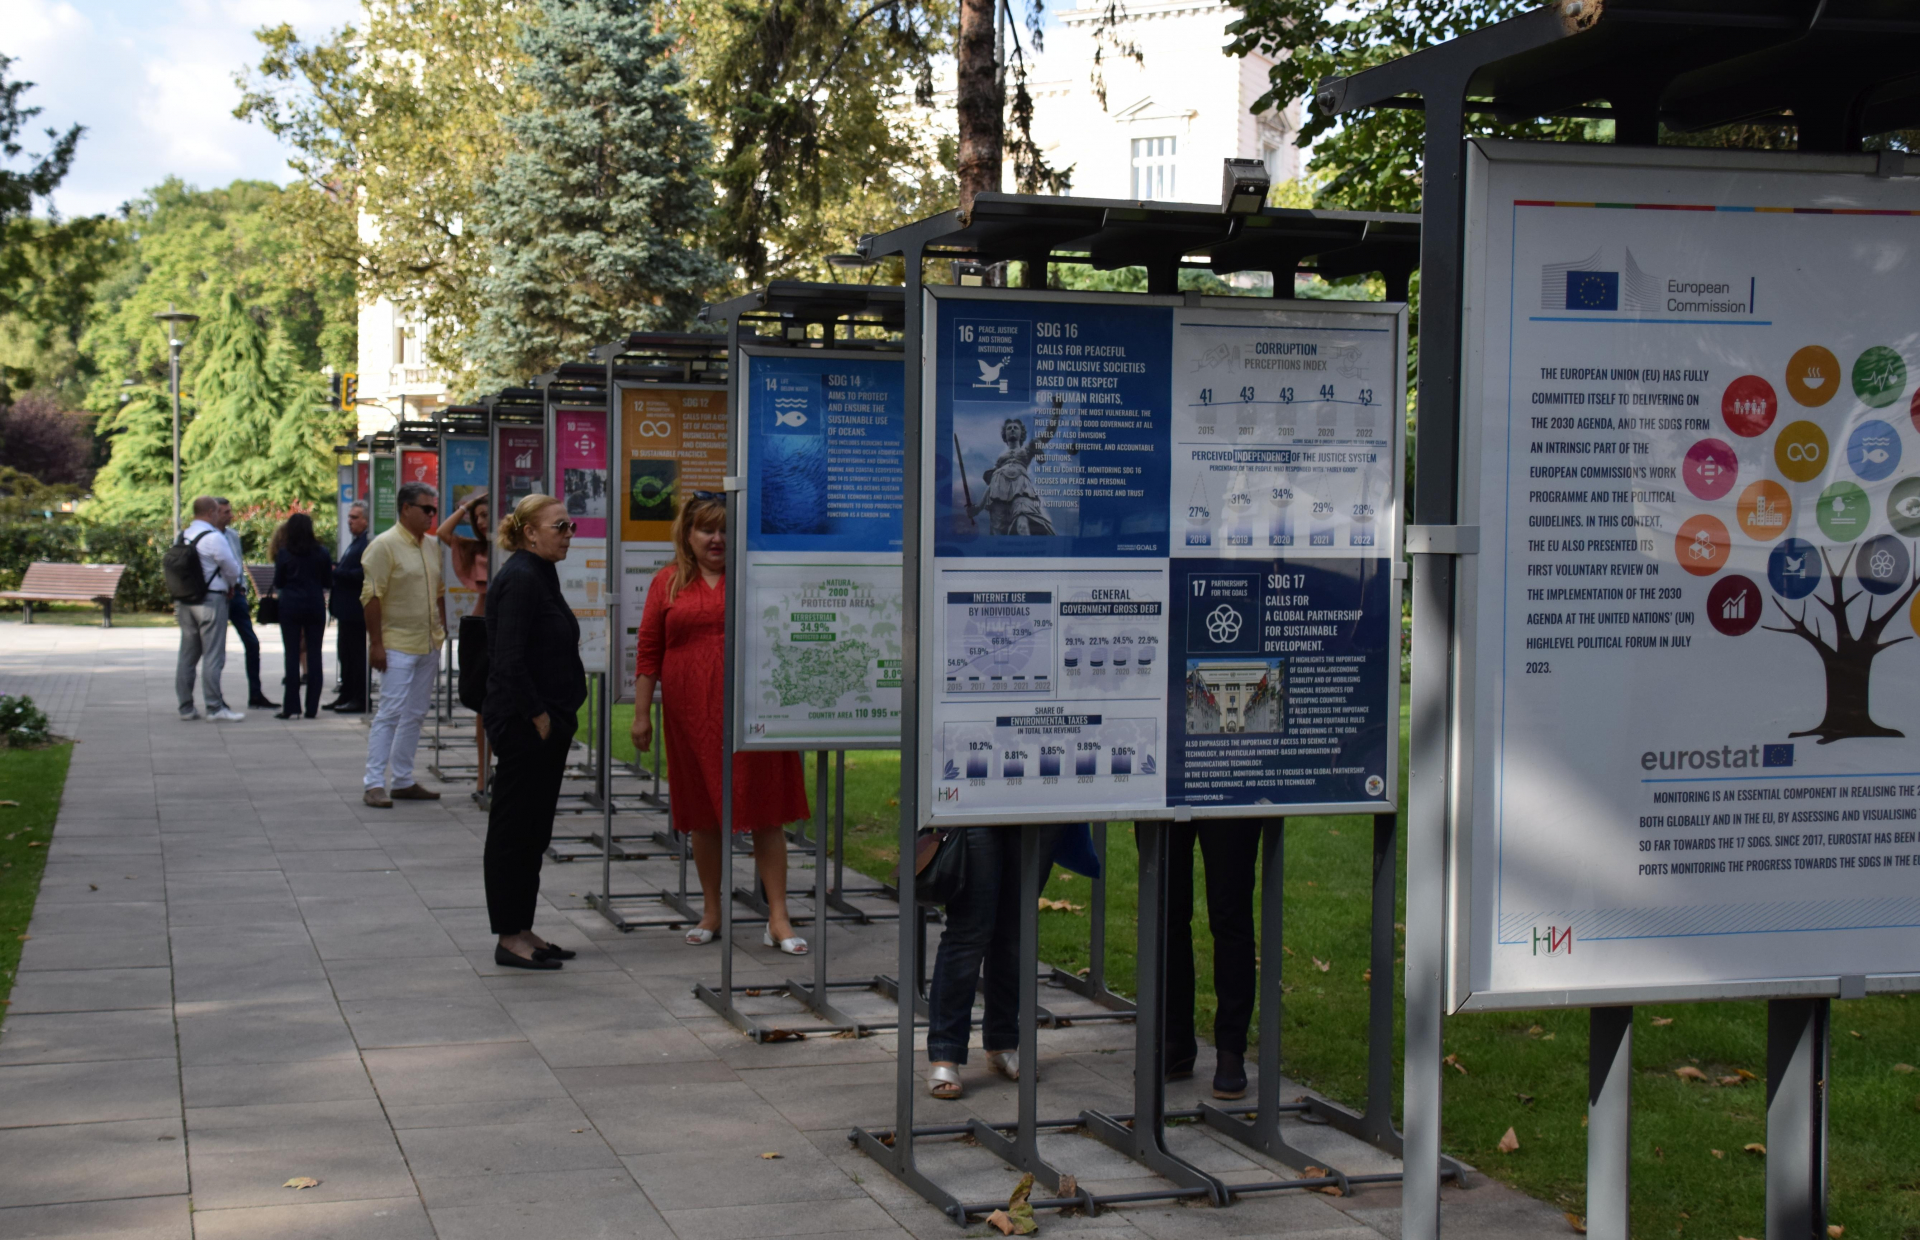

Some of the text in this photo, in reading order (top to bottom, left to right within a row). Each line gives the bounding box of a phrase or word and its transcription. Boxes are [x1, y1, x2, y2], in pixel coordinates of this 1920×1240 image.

[1668, 279, 1729, 296] European
[1667, 299, 1746, 314] Commission
[959, 325, 974, 342] 16
[997, 326, 1018, 334] JUSTICE
[1036, 322, 1078, 338] SDG 16
[991, 336, 1012, 344] STRONG
[978, 346, 1014, 354] INSTITUTIONS
[1037, 344, 1126, 357] CALLS FOR PEACEFUL
[1255, 342, 1317, 356] CORRUPTION
[1037, 360, 1146, 373] AND INCLUSIVE SOCIETIES
[1244, 359, 1327, 371] PERCEPTIONS INDEX
[828, 375, 860, 387] SDG 14
[1541, 368, 1709, 383] THE EUROPEAN UNION (EU) HAS FULLY
[766, 378, 777, 391] 14
[1036, 375, 1118, 388] BASED ON RESPECT
[828, 391, 888, 401] AIMS TO PROTECT
[1036, 391, 1123, 405] FOR HUMAN RIGHTS,
[1200, 384, 1373, 403] 41 43 43 44 43
[1532, 392, 1699, 405] COMMITTED ITSELF TO DELIVERING ON
[634, 400, 644, 412] 12
[682, 398, 709, 407] SDG 12
[828, 403, 885, 413] AND ENSURE THE
[827, 415, 888, 425] SUSTAINABLE USE
[827, 428, 867, 437] OF OCEANS.
[1192, 450, 1377, 463] PERCEIVED INDEPENDENCE OF THE JUSTICE SYSTEM
[1189, 489, 1374, 517] 27% 31% 34% 29% 28%
[827, 579, 851, 587] NATURA
[1268, 574, 1305, 589] SDG 17
[828, 588, 849, 597] 2000
[1193, 580, 1206, 597] 17
[973, 593, 1026, 602] INTERNET USE
[1092, 589, 1130, 600] GENERAL
[801, 599, 875, 608] PROTECTED AREAS
[1265, 595, 1309, 606] CALLS FOR
[969, 607, 1030, 616] BY INDIVIDUALS
[1062, 603, 1158, 614] GOVERNMENT GROSS DEBT
[793, 613, 833, 621] TERRESTRIAL
[1265, 610, 1363, 621] A GLOBAL PARTNERSHIP
[800, 623, 829, 632] 34.9%
[1265, 625, 1337, 636] FOR SUSTAINABLE
[1265, 641, 1324, 652] DEVELOPMENT.
[855, 709, 868, 717] 110
[871, 708, 887, 717] 995
[1035, 707, 1055, 715] SHARE
[1010, 716, 1088, 726] ENVIRONMENTAL TAXES
[1054, 726, 1081, 734] REVENUES
[969, 742, 1135, 760] 10.2% 8.81% 9.85% 9.89% 9.06%
[1640, 744, 1759, 770] eurostat
[1654, 785, 1915, 803] MONITORING IS AN ESSENTIAL COMPONENT IN REALISING THE
